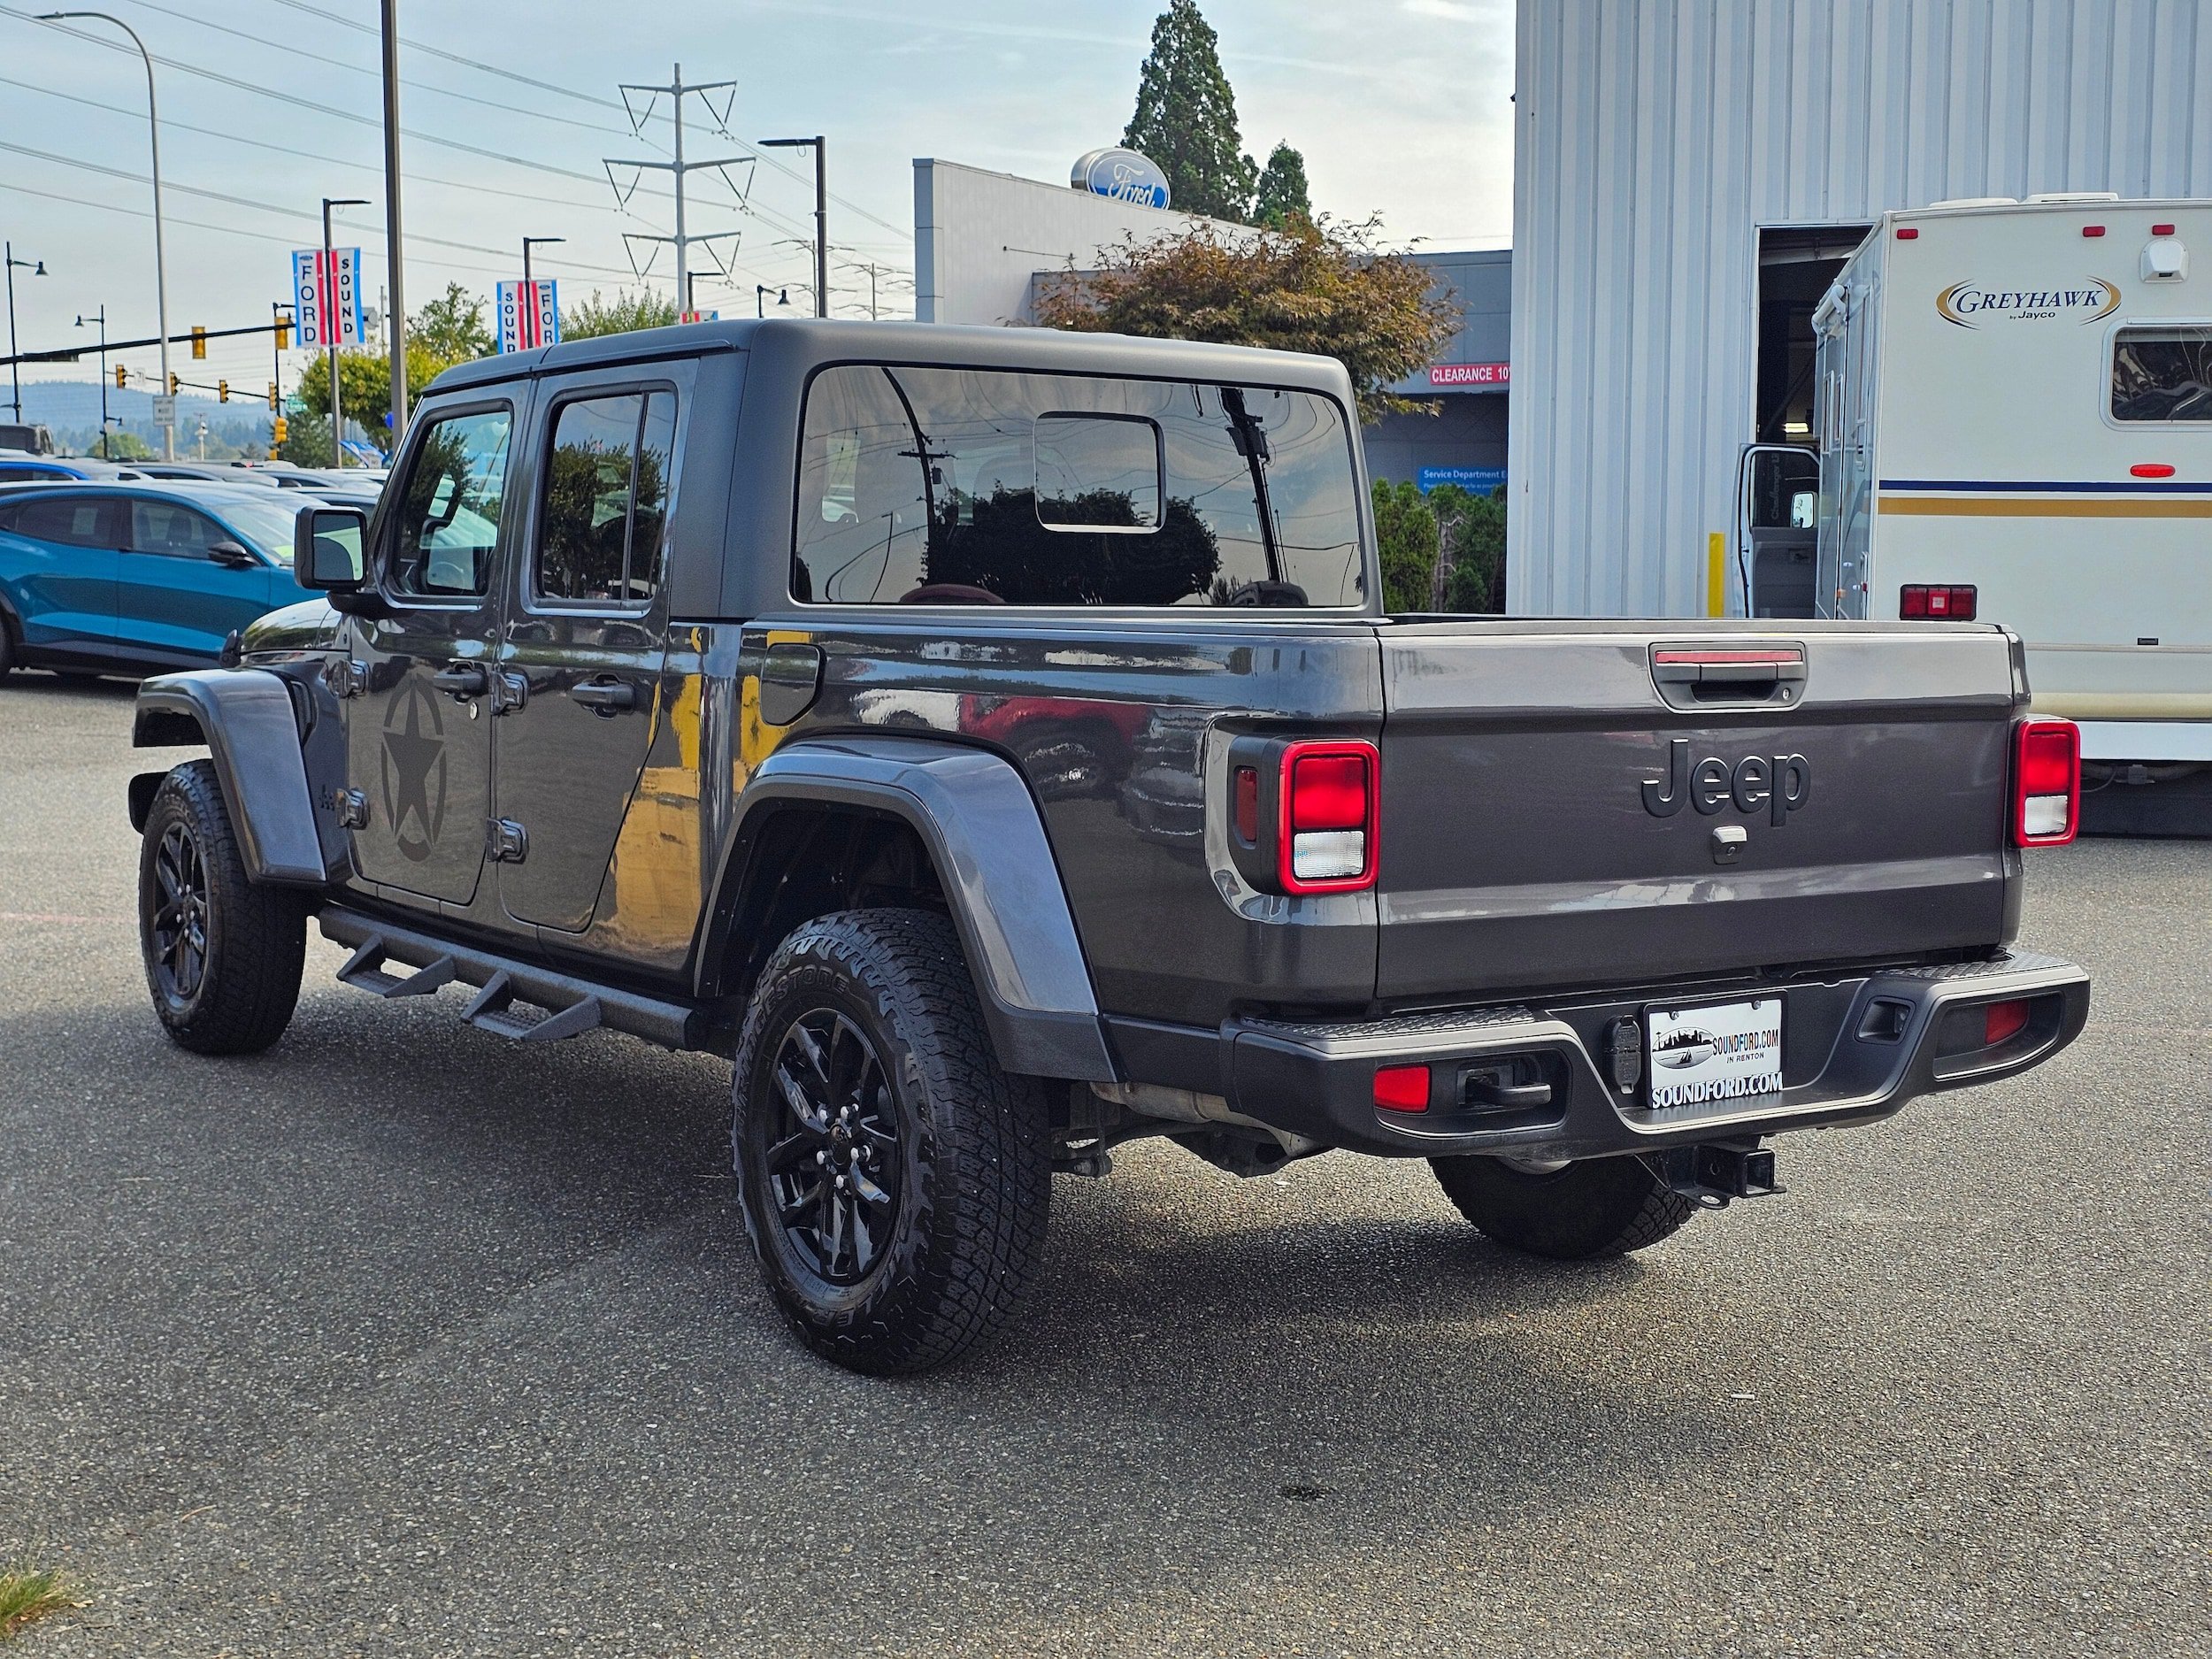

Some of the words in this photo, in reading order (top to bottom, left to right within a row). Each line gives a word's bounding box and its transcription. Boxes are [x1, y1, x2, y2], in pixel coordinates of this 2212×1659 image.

[1108, 164, 1155, 208] Ford
[301, 265, 316, 342] FORD
[341, 258, 353, 334] SOUND
[1956, 290, 2102, 313] GREYHAWK
[541, 294, 553, 343] FOR
[2017, 311, 2056, 320] Jayco
[1432, 366, 1493, 382] CLEARANCE
[1424, 470, 1452, 479] Service
[1453, 470, 1500, 480] Department
[1642, 738, 1811, 827] Jeep
[1712, 1029, 1778, 1056] SOUNDFORD.COM
[1736, 1051, 1764, 1063] RENTON
[1651, 1071, 1783, 1110] SOUNDFORD.COM
